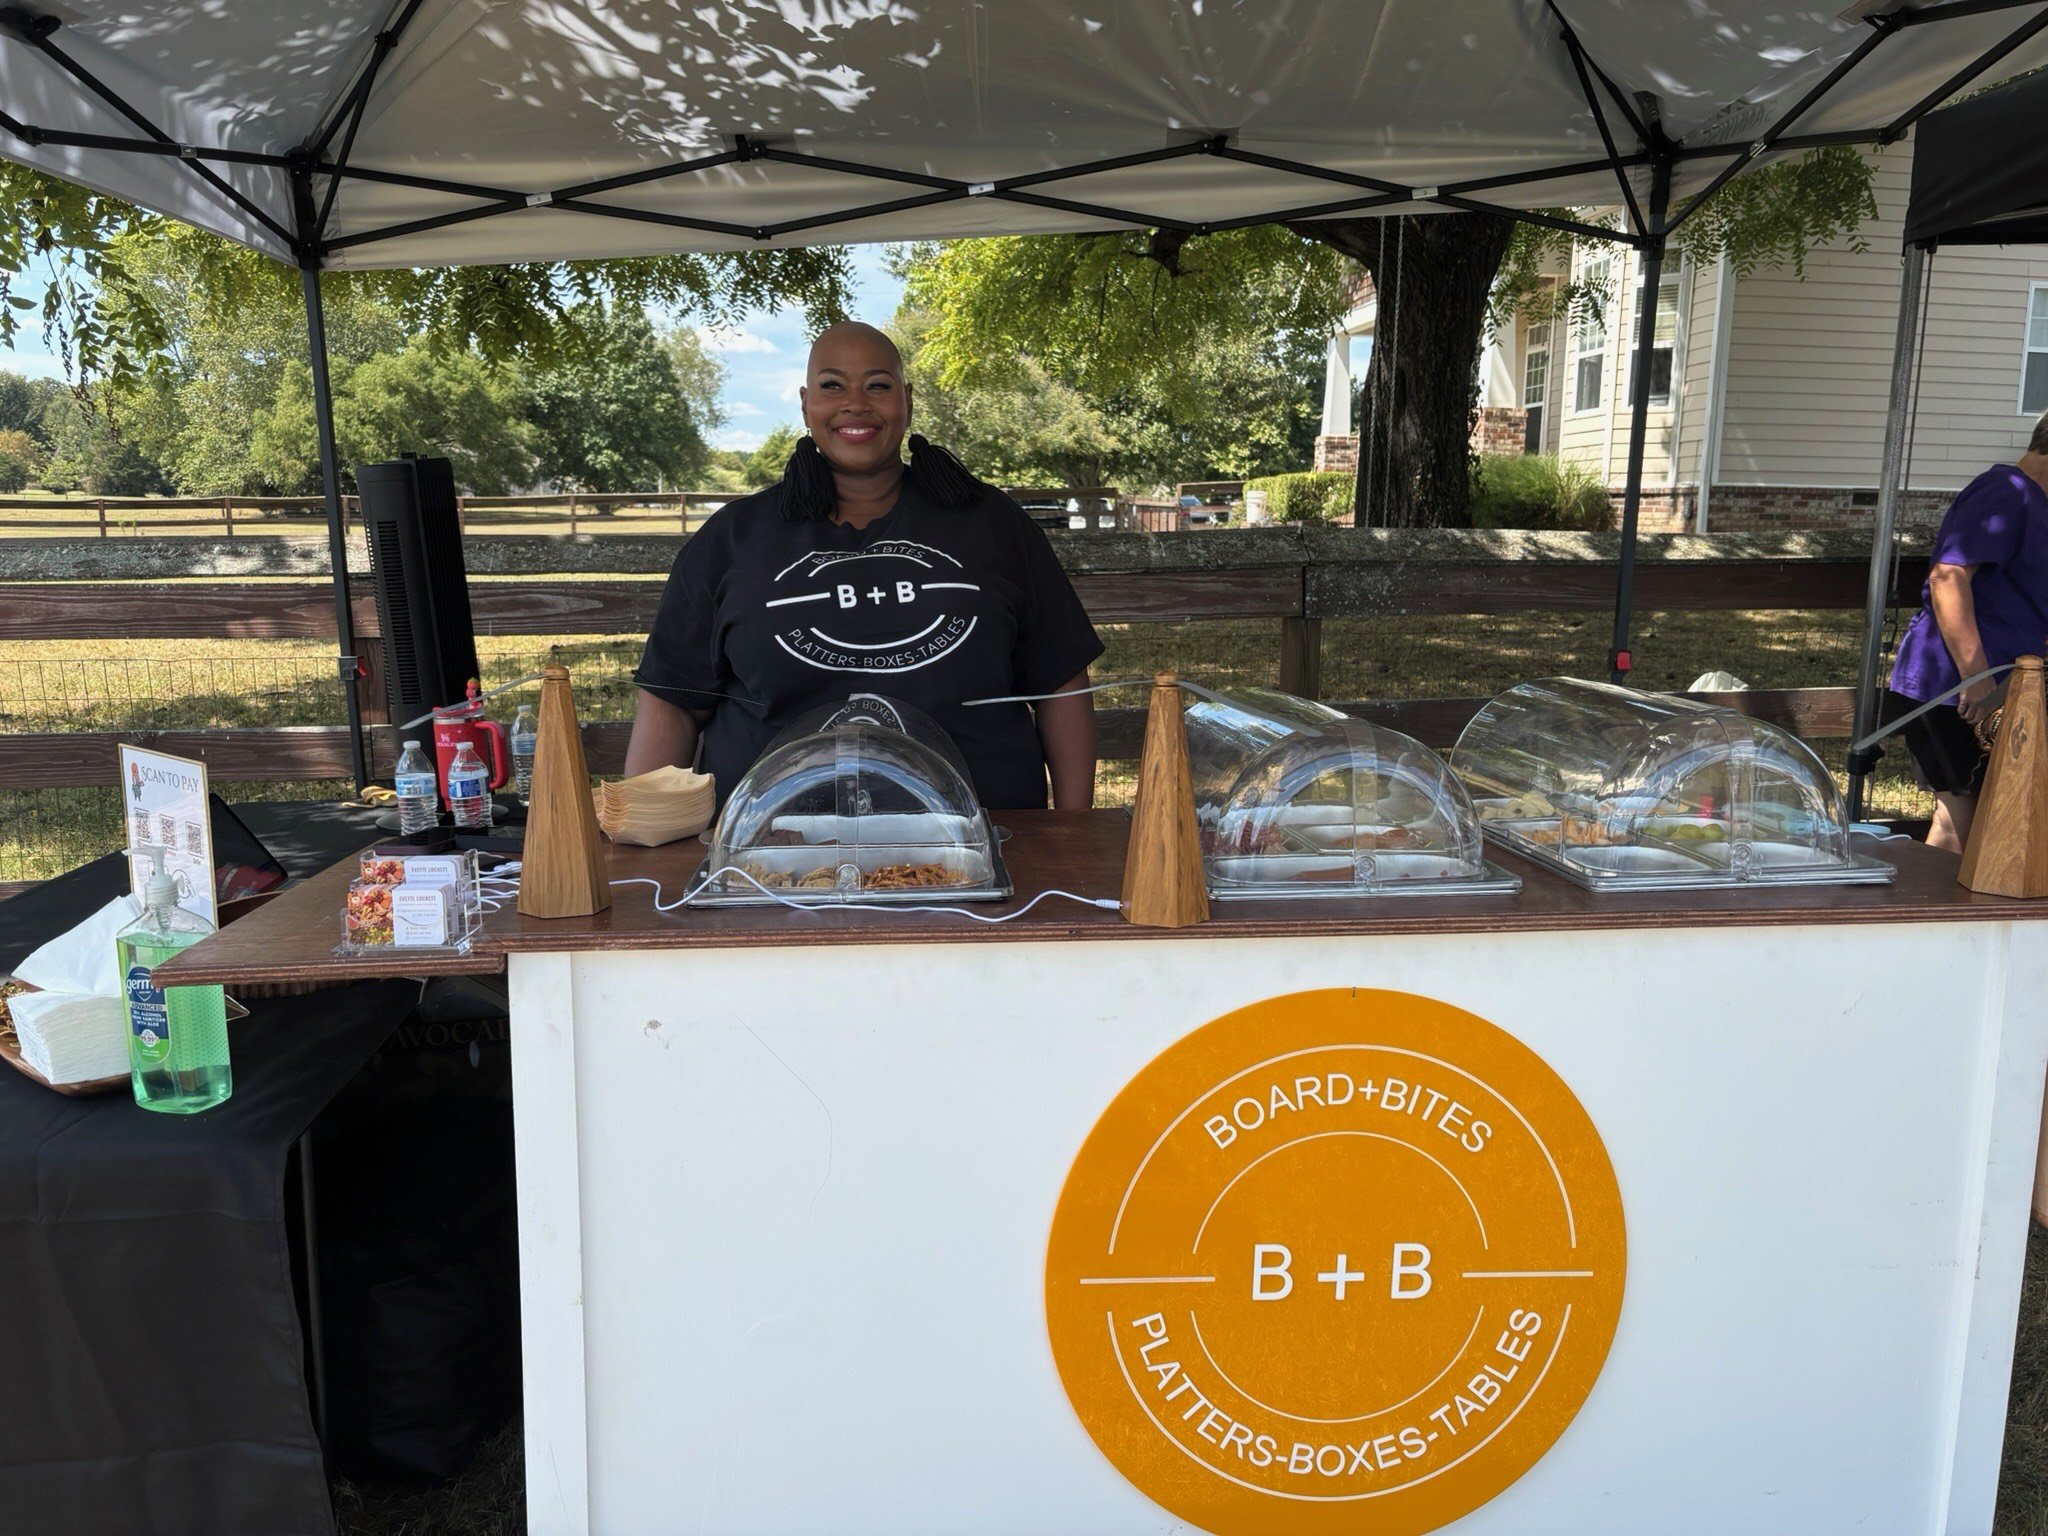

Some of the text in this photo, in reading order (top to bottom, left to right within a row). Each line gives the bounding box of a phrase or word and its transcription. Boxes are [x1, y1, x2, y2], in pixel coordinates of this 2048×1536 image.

[837, 581, 916, 609] B + B
[141, 766, 199, 793] SCAN TO PAY
[1204, 1072, 1493, 1154] BOARD+BITES
[1252, 1242, 1433, 1301] B + B
[1131, 1307, 1542, 1477] PLATTERS-BOXES-TABLES
